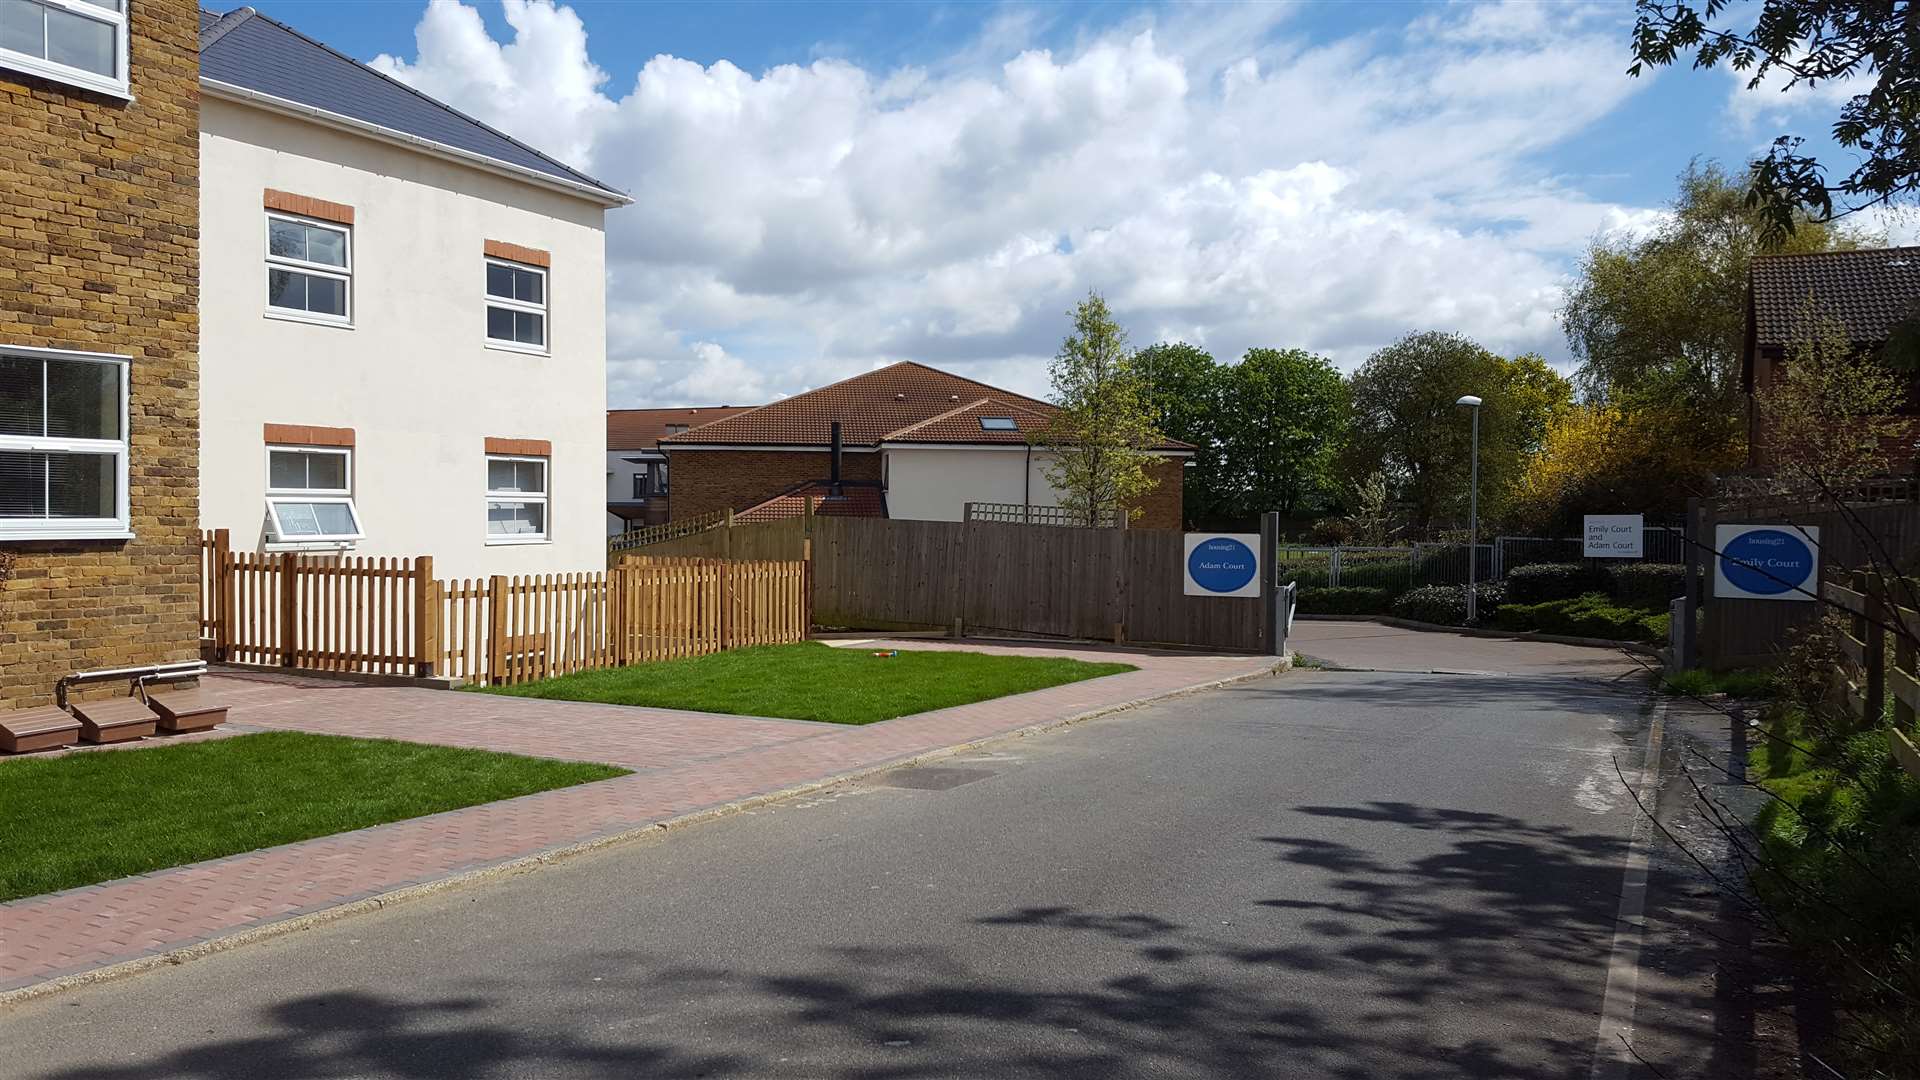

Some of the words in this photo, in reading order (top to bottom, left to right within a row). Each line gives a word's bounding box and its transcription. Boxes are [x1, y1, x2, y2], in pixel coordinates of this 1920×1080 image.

[1589, 525, 1609, 533] Emily
[1611, 525, 1632, 533] Court
[1588, 541, 1610, 549] Adam
[1612, 541, 1633, 549] Court
[1222, 562, 1245, 570] Court
[1767, 558, 1801, 568] Court
